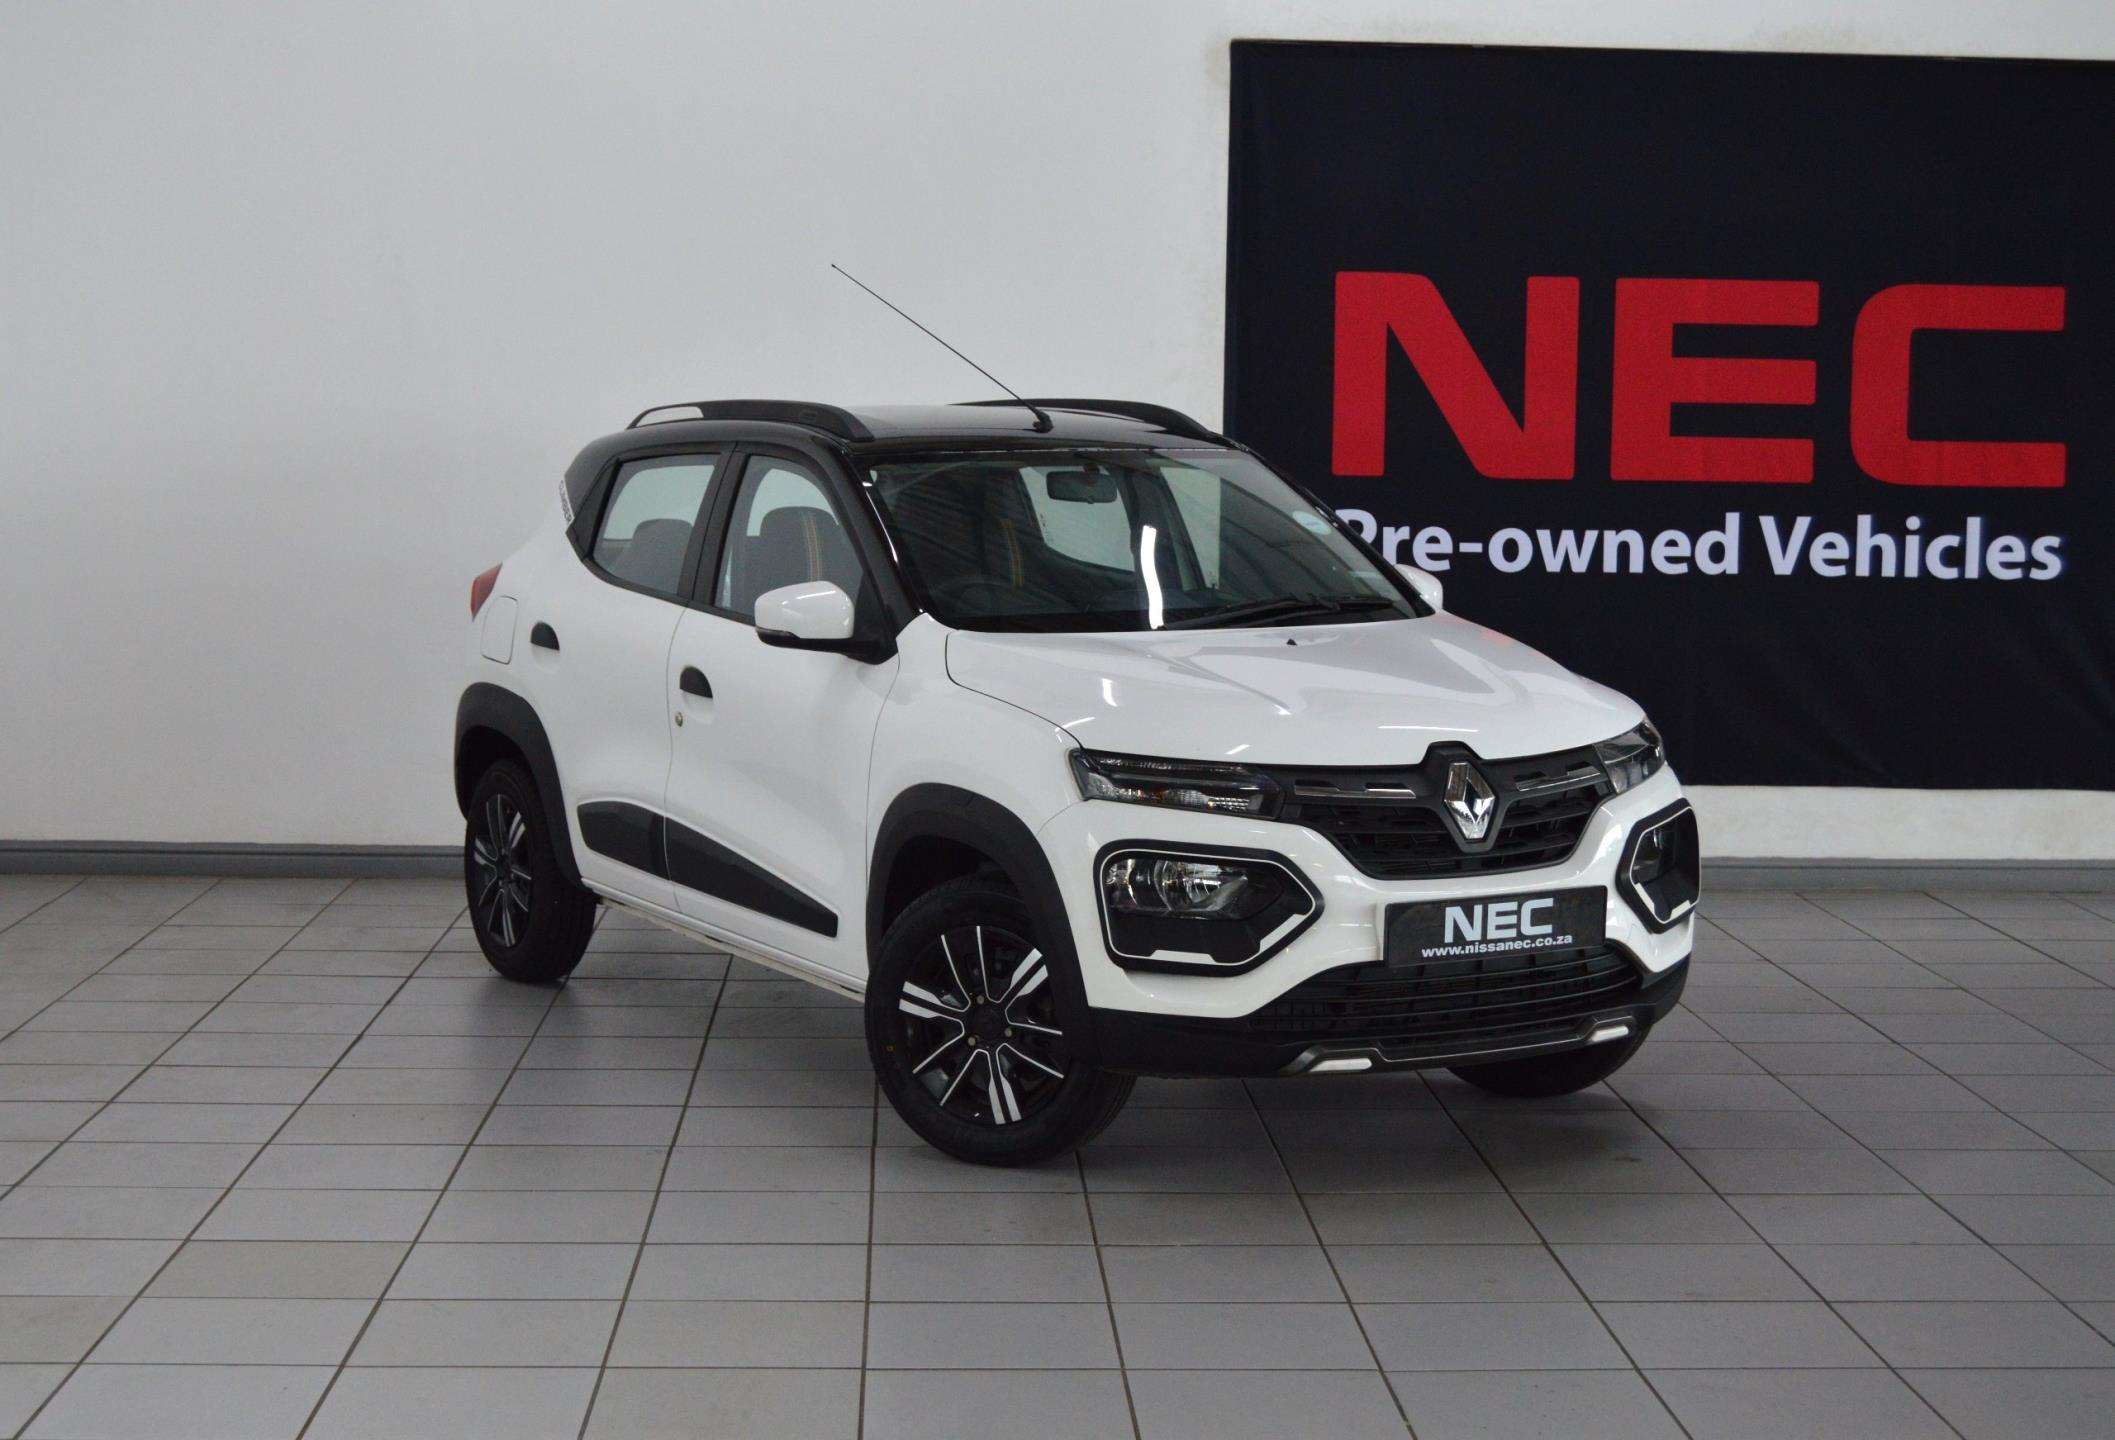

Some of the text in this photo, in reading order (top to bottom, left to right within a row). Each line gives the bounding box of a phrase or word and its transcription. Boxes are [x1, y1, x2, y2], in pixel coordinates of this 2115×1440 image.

[1332, 271, 2065, 487] NEC
[1335, 508, 2062, 581] Pre-owned Vehicles
[1421, 933, 1572, 958] www.nissanec.co.za
[1444, 898, 1554, 943] NEC
